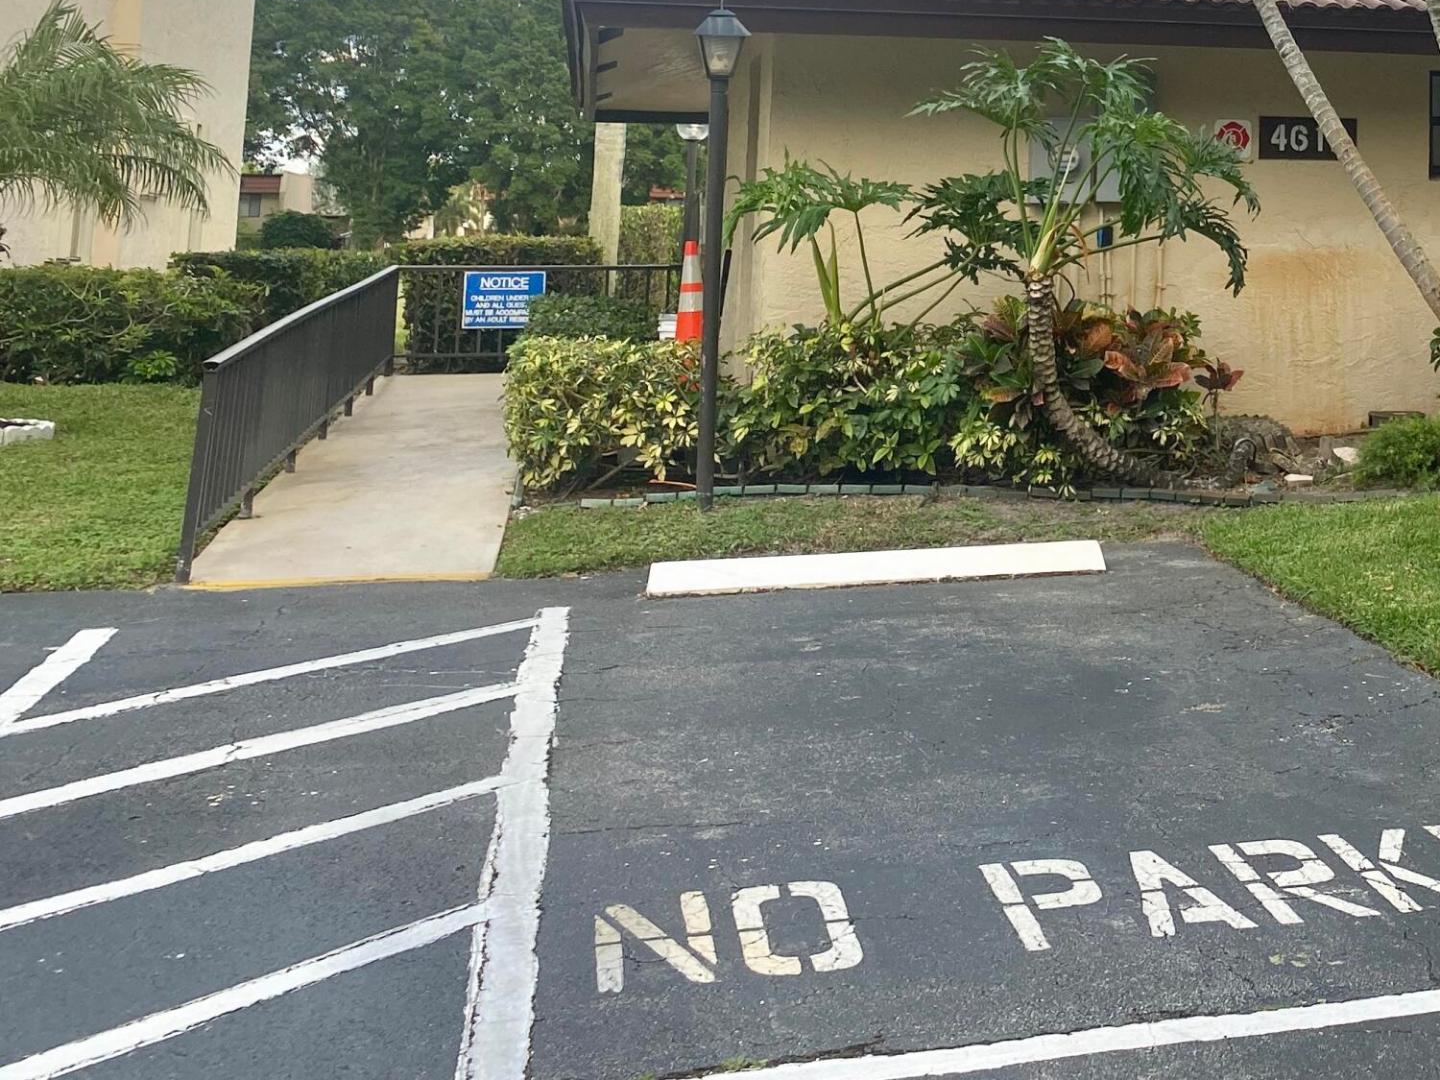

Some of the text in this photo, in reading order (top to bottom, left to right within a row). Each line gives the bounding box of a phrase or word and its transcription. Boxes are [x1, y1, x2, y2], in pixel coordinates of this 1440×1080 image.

[1270, 124, 1324, 152] 461
[480, 277, 530, 288] NOTICE
[594, 880, 864, 994] NO
